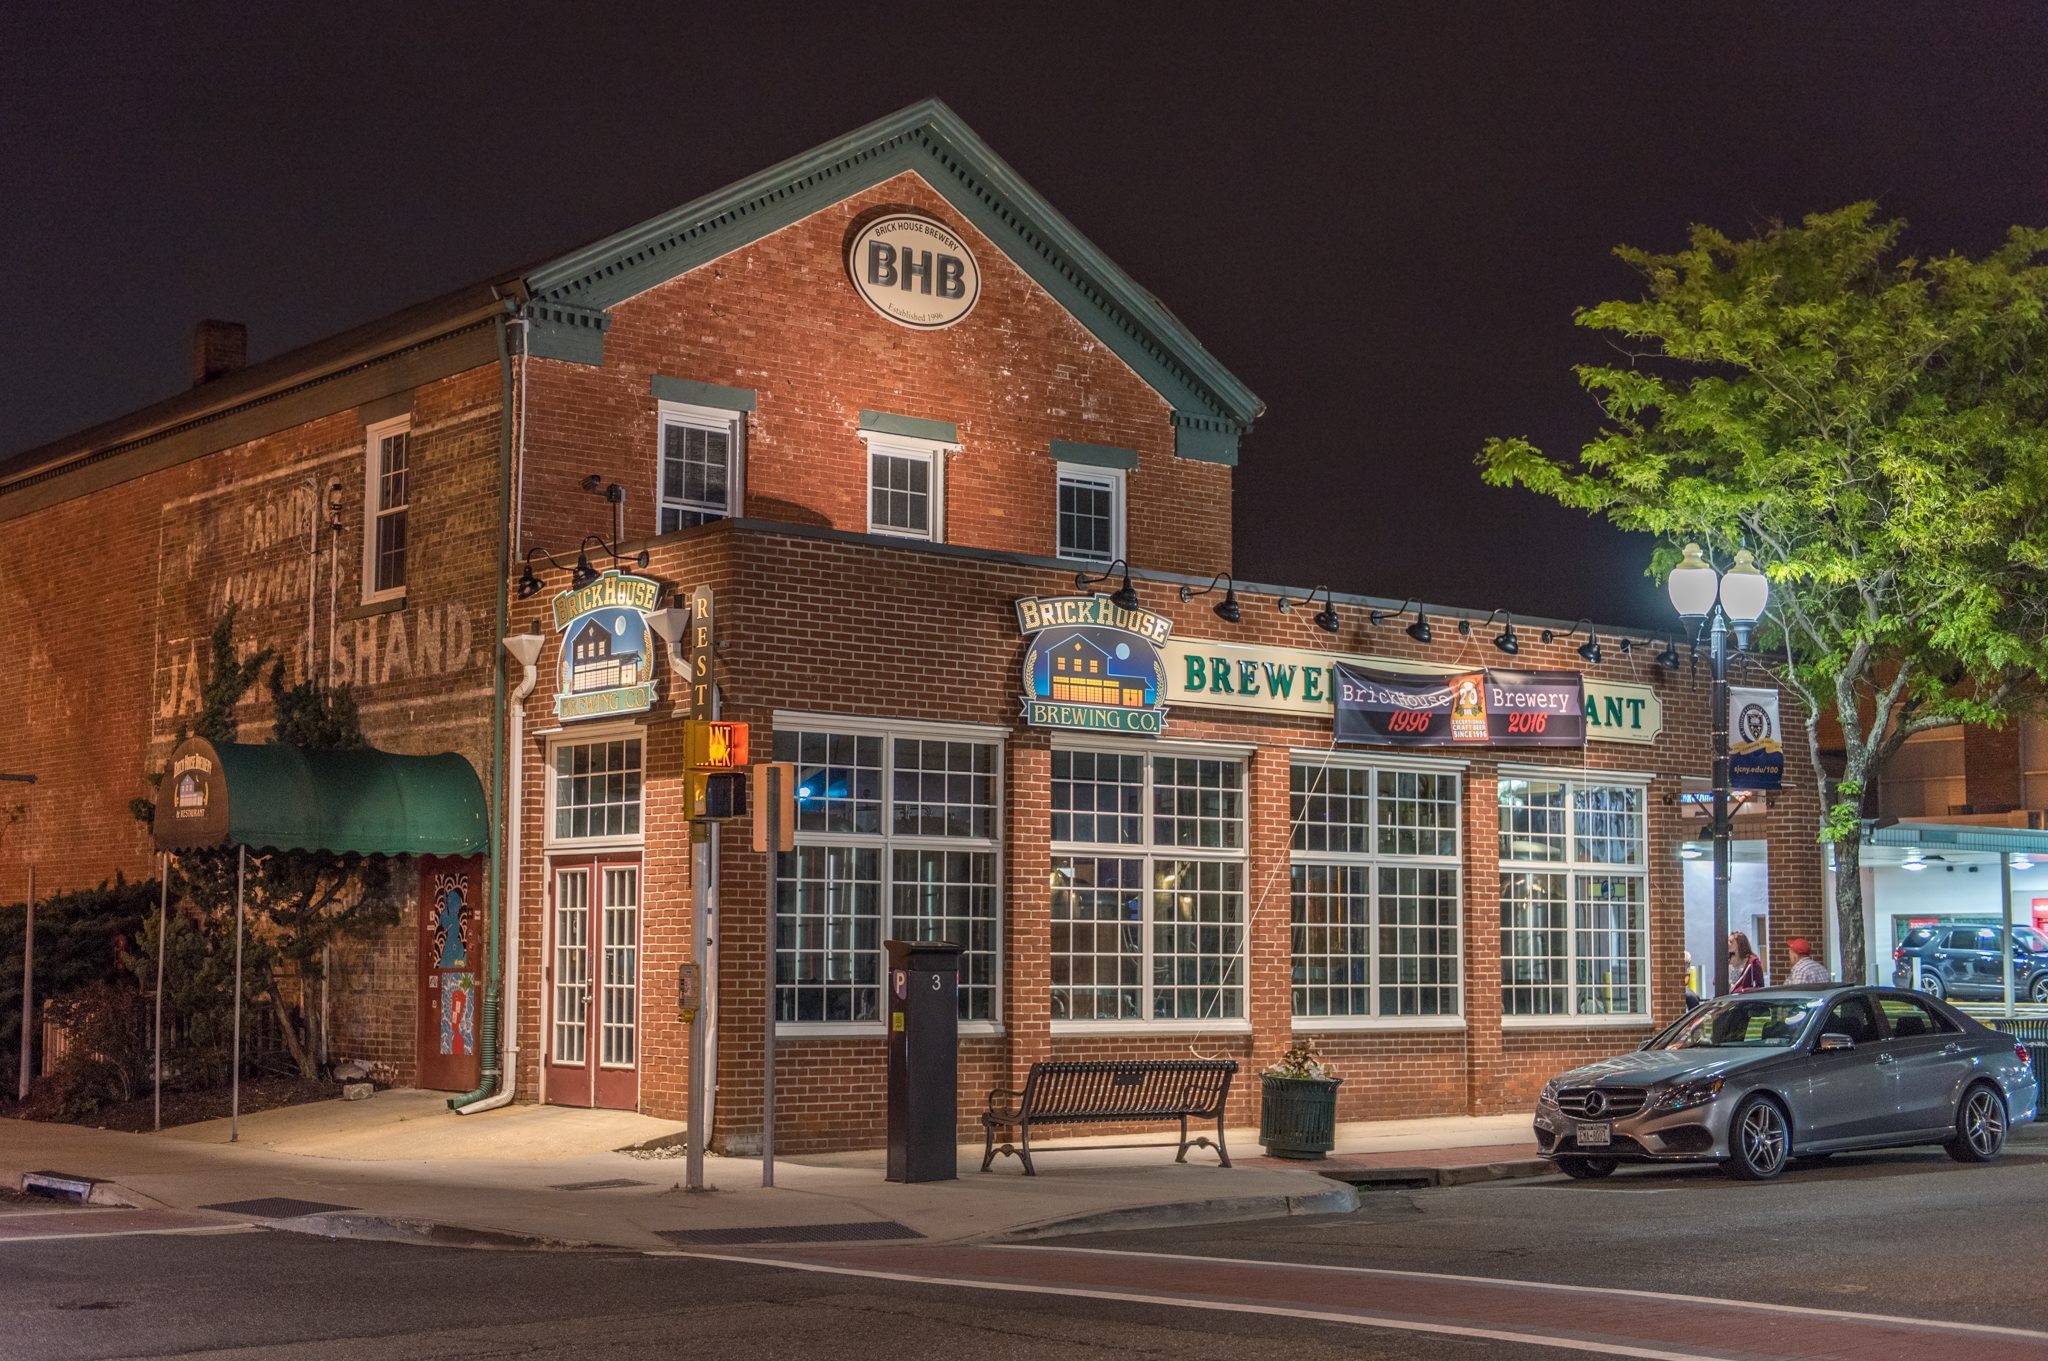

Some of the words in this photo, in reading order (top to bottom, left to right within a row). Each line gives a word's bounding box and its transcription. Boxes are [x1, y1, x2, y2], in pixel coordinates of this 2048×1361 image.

[874, 222, 897, 237] BRICK
[897, 221, 924, 233] HOUSE
[924, 226, 960, 252] BREWERY
[868, 239, 966, 300] BHB
[887, 302, 926, 323] Established
[927, 311, 944, 323] 1996
[561, 692, 619, 717] BREWING
[625, 687, 648, 707] CO.
[1492, 687, 1569, 713] Brewery
[1034, 704, 1121, 728] BREWING
[1126, 713, 1157, 732] CO.
[1388, 709, 1432, 733] 1996
[1508, 711, 1548, 734] 2016
[1453, 731, 1473, 739] SINCE
[896, 972, 905, 994] P
[931, 974, 941, 991] 3
